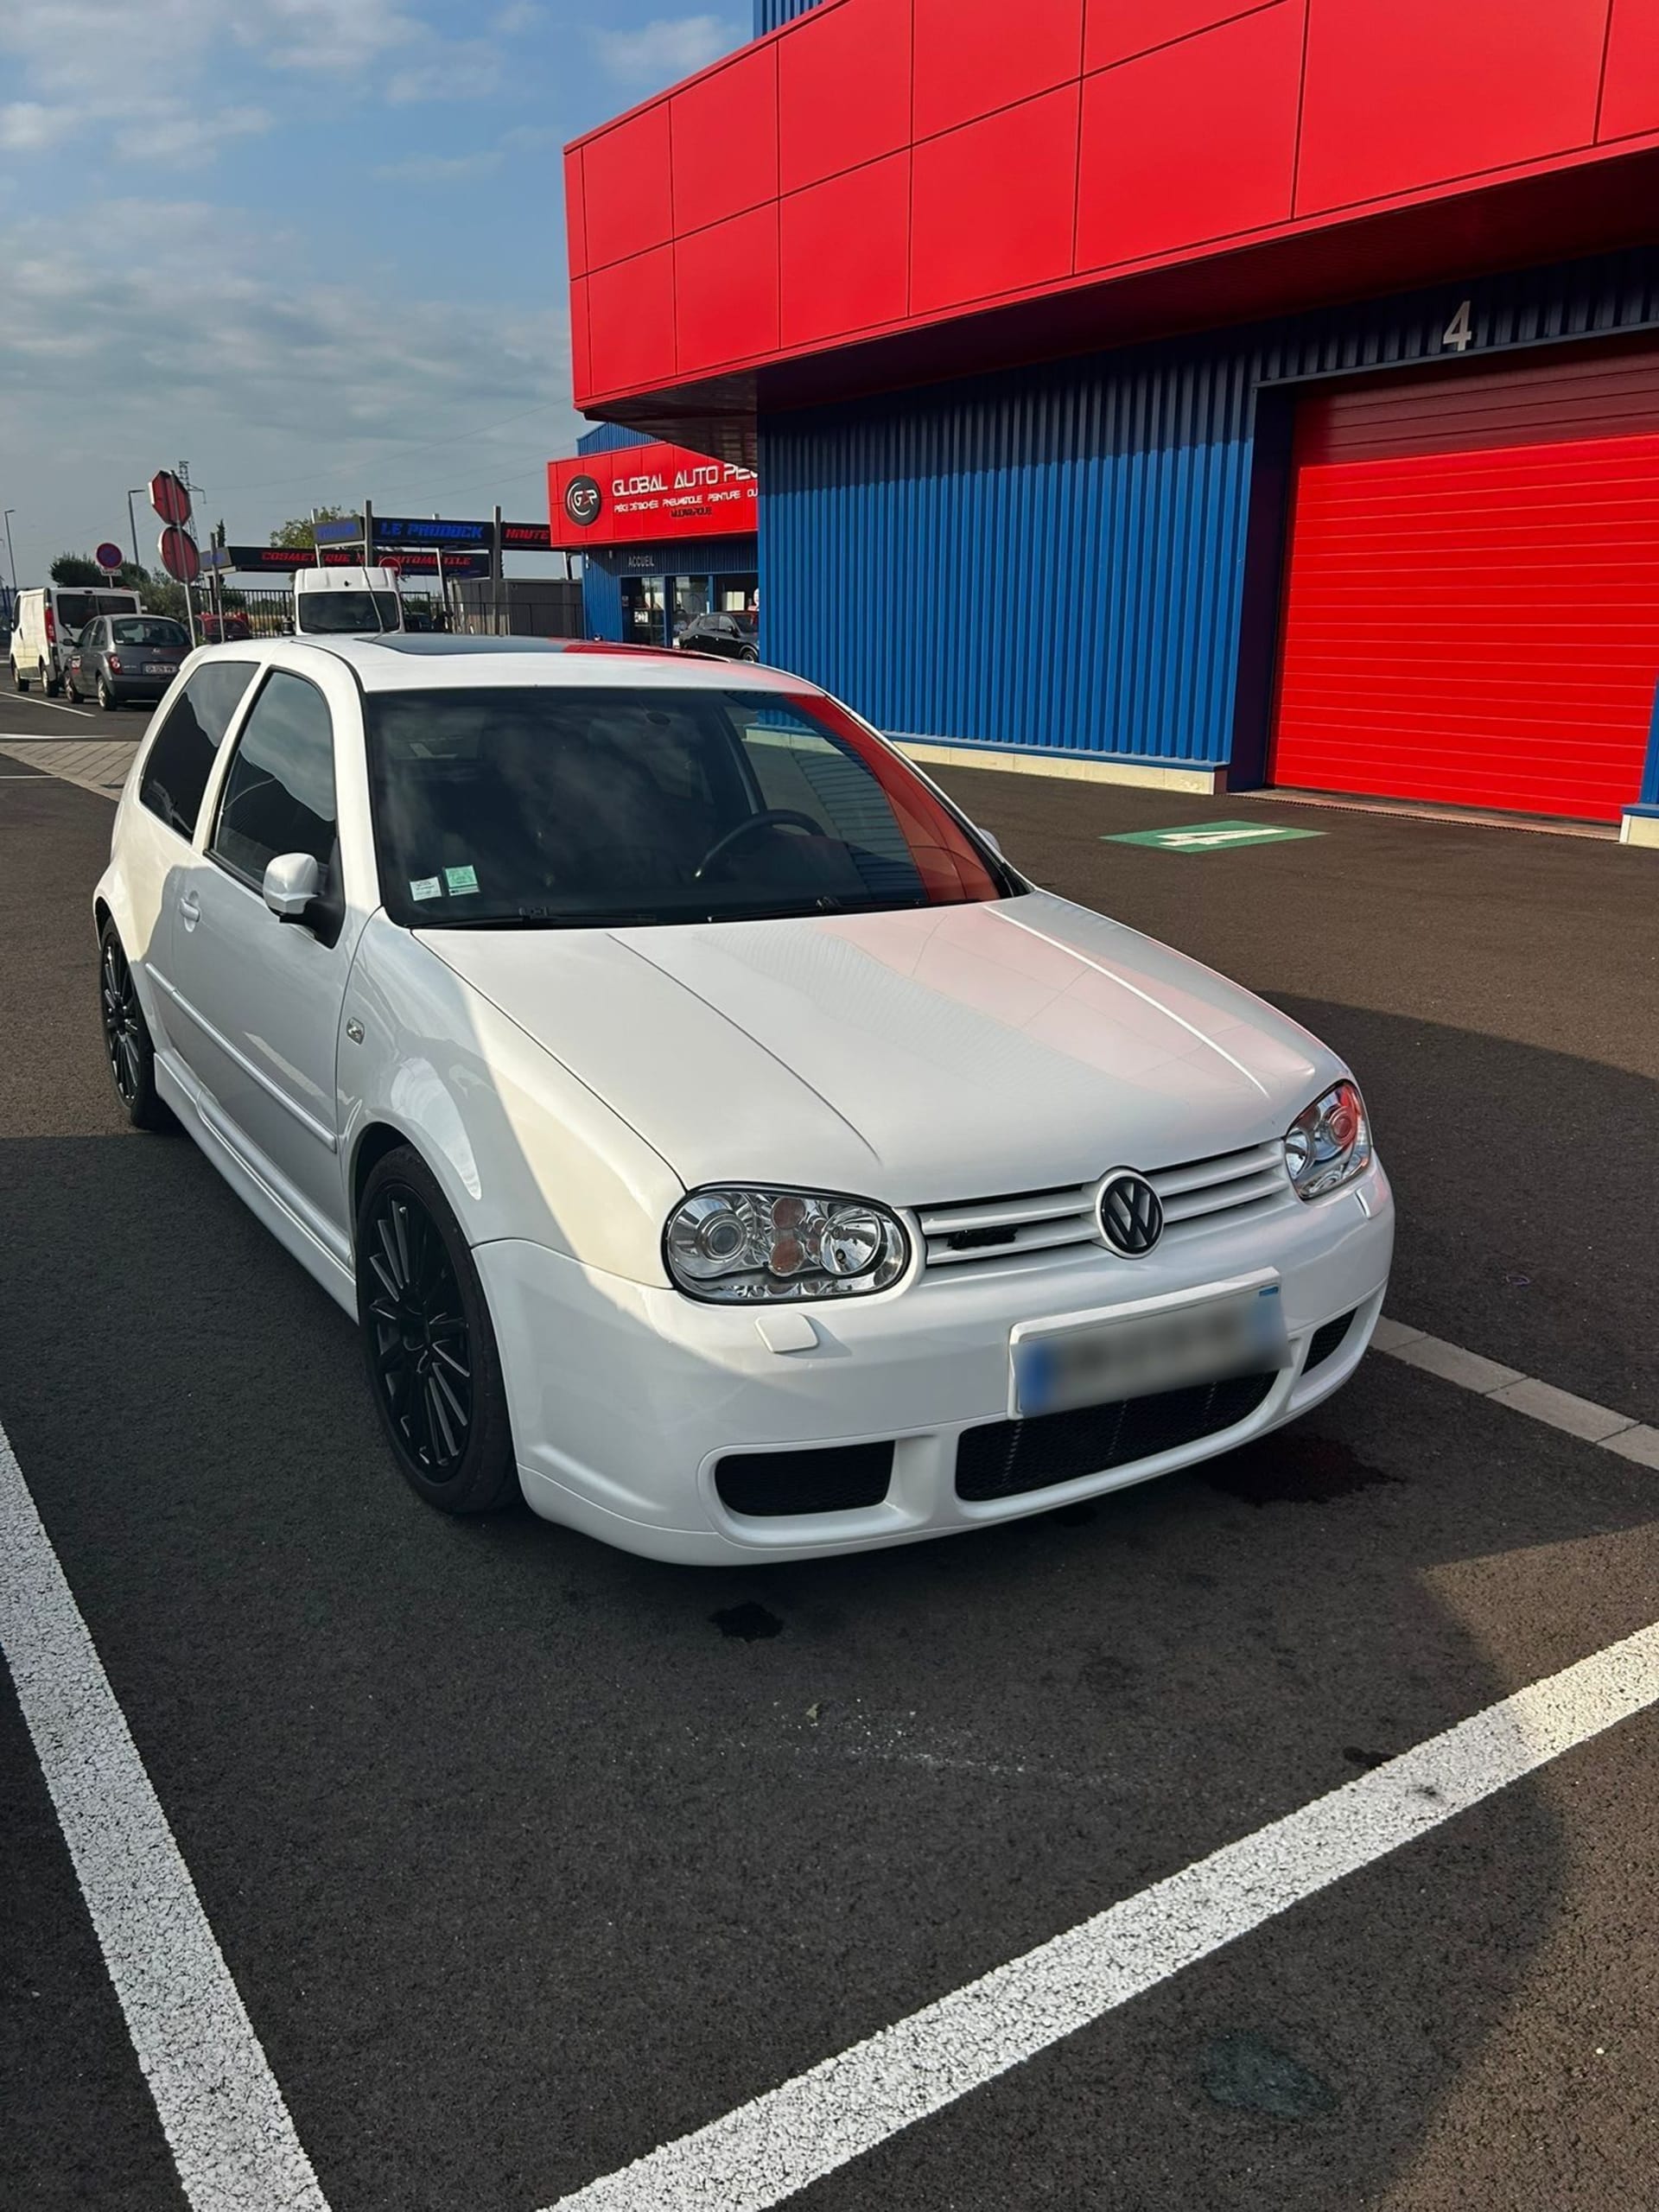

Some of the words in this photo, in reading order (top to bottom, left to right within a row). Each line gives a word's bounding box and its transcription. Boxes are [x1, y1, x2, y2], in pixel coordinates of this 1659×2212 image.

[1442, 300, 1472, 353] 4
[612, 473, 668, 497] GLOBAL
[674, 465, 719, 489] AUTO
[381, 522, 402, 536] LE
[262, 551, 351, 564] COSMETQUE
